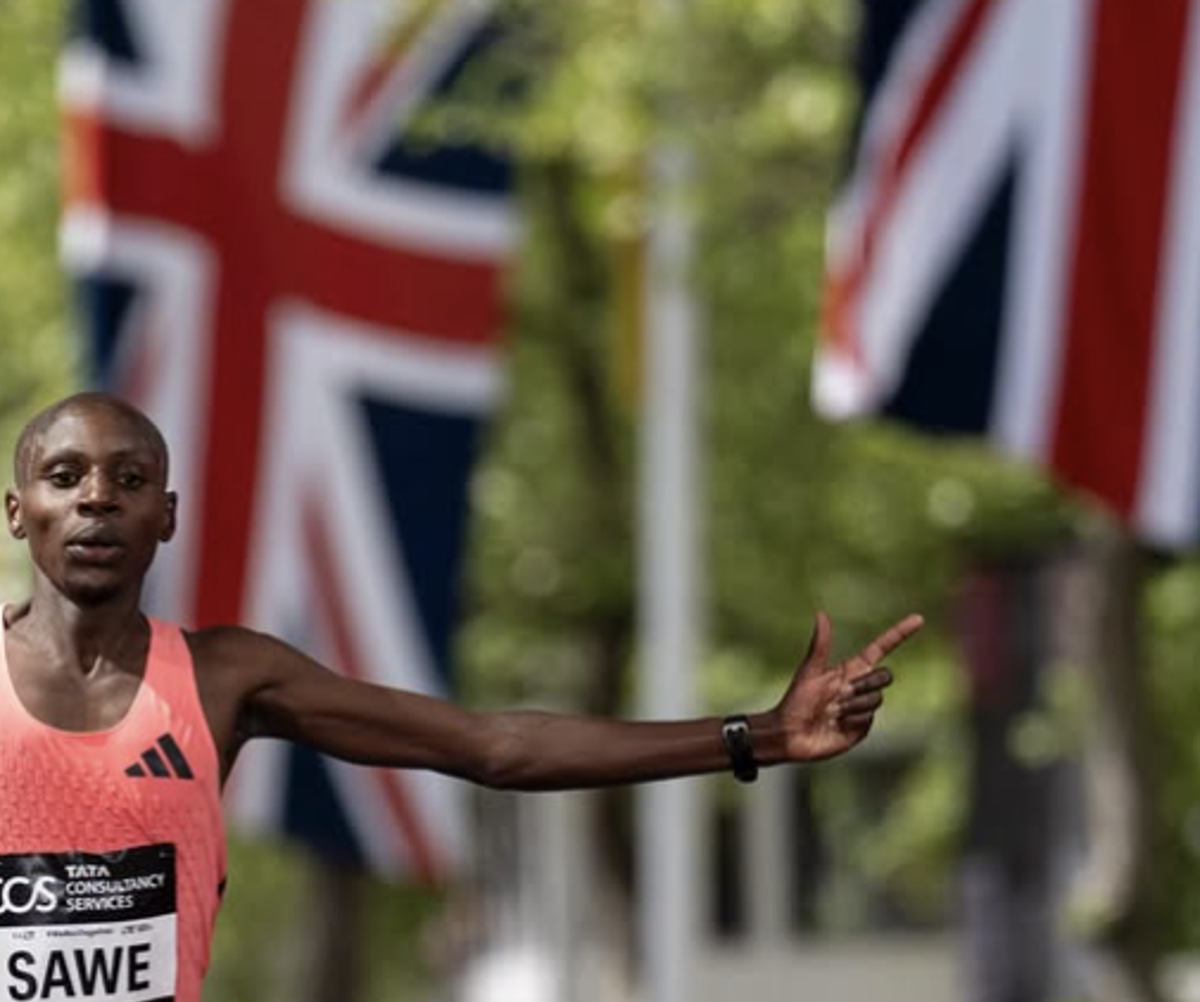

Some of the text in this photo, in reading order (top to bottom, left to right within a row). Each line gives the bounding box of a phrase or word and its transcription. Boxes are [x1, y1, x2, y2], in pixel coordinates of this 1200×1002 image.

[65, 865, 110, 877] TATA
[65, 873, 166, 895] CONSULTANCY
[65, 895, 134, 912] SERVICES
[8, 943, 151, 1001] SAWE
